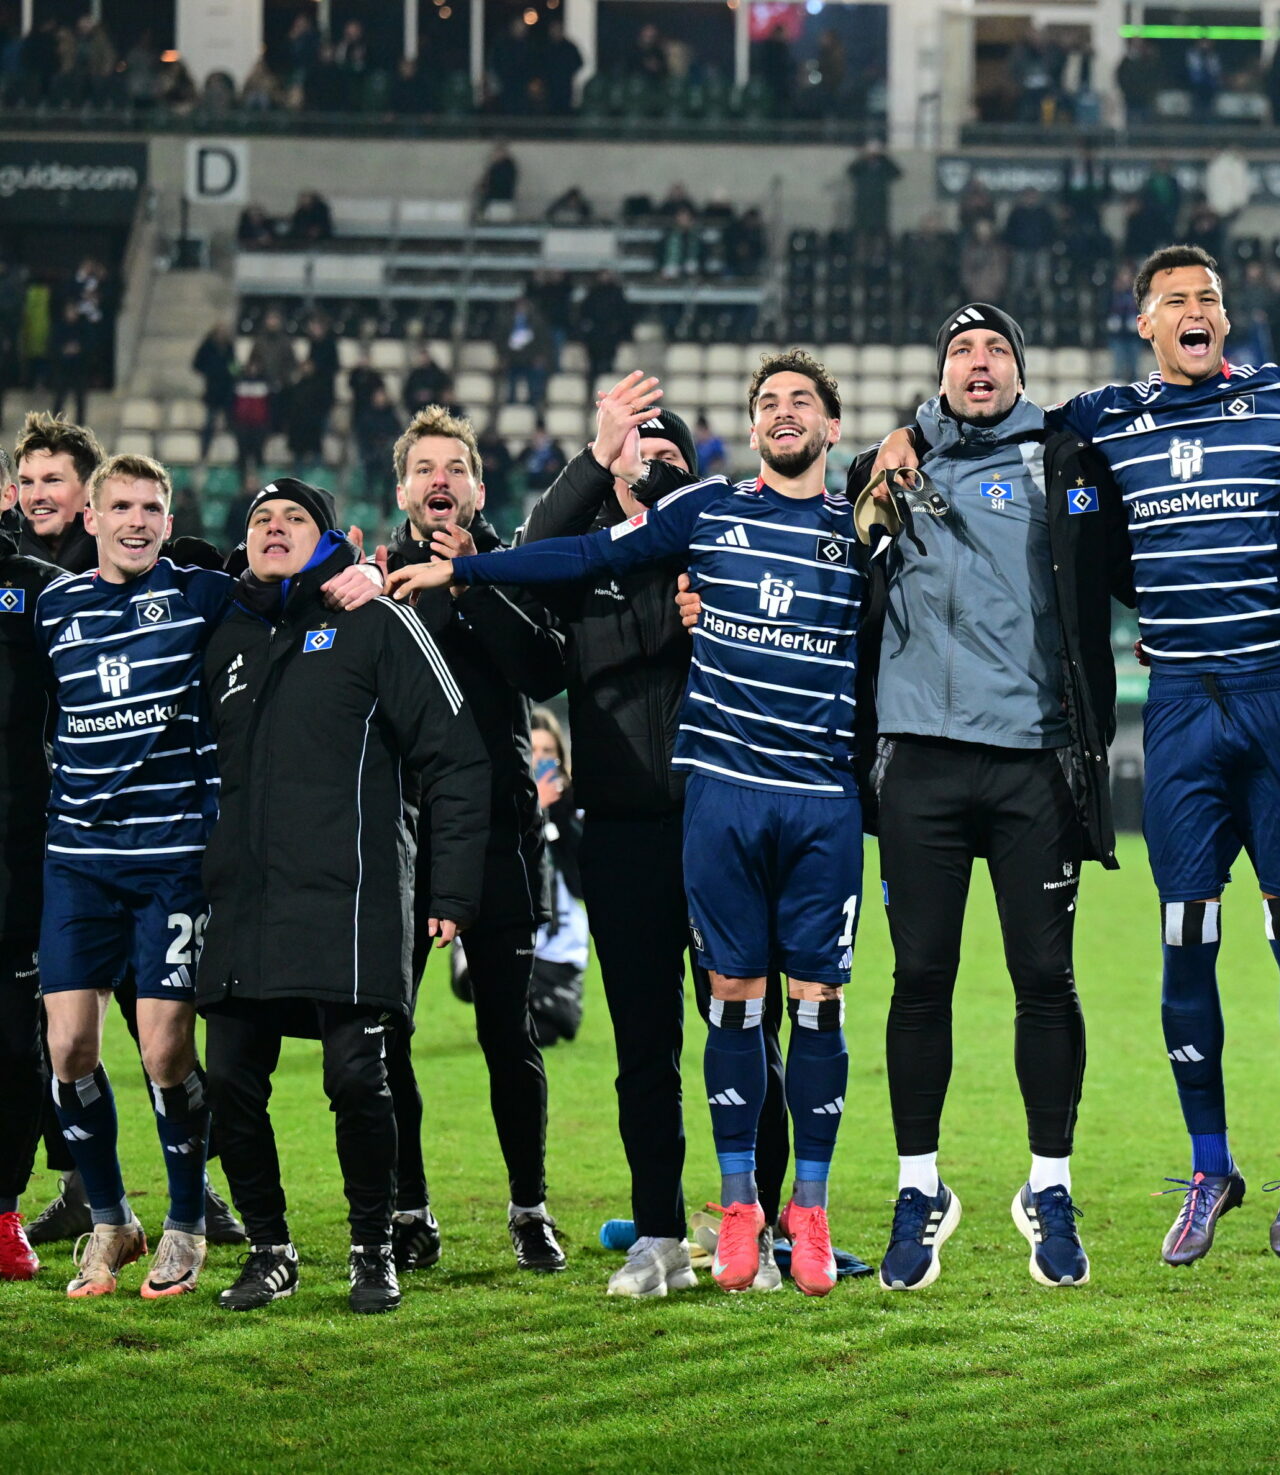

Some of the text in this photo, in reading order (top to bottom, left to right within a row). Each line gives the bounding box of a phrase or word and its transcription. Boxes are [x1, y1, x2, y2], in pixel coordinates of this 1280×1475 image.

[196, 147, 239, 197] D
[991, 498, 1005, 510] SH
[1130, 488, 1259, 519] HanseMerkur
[702, 610, 837, 655] HanseMerkur
